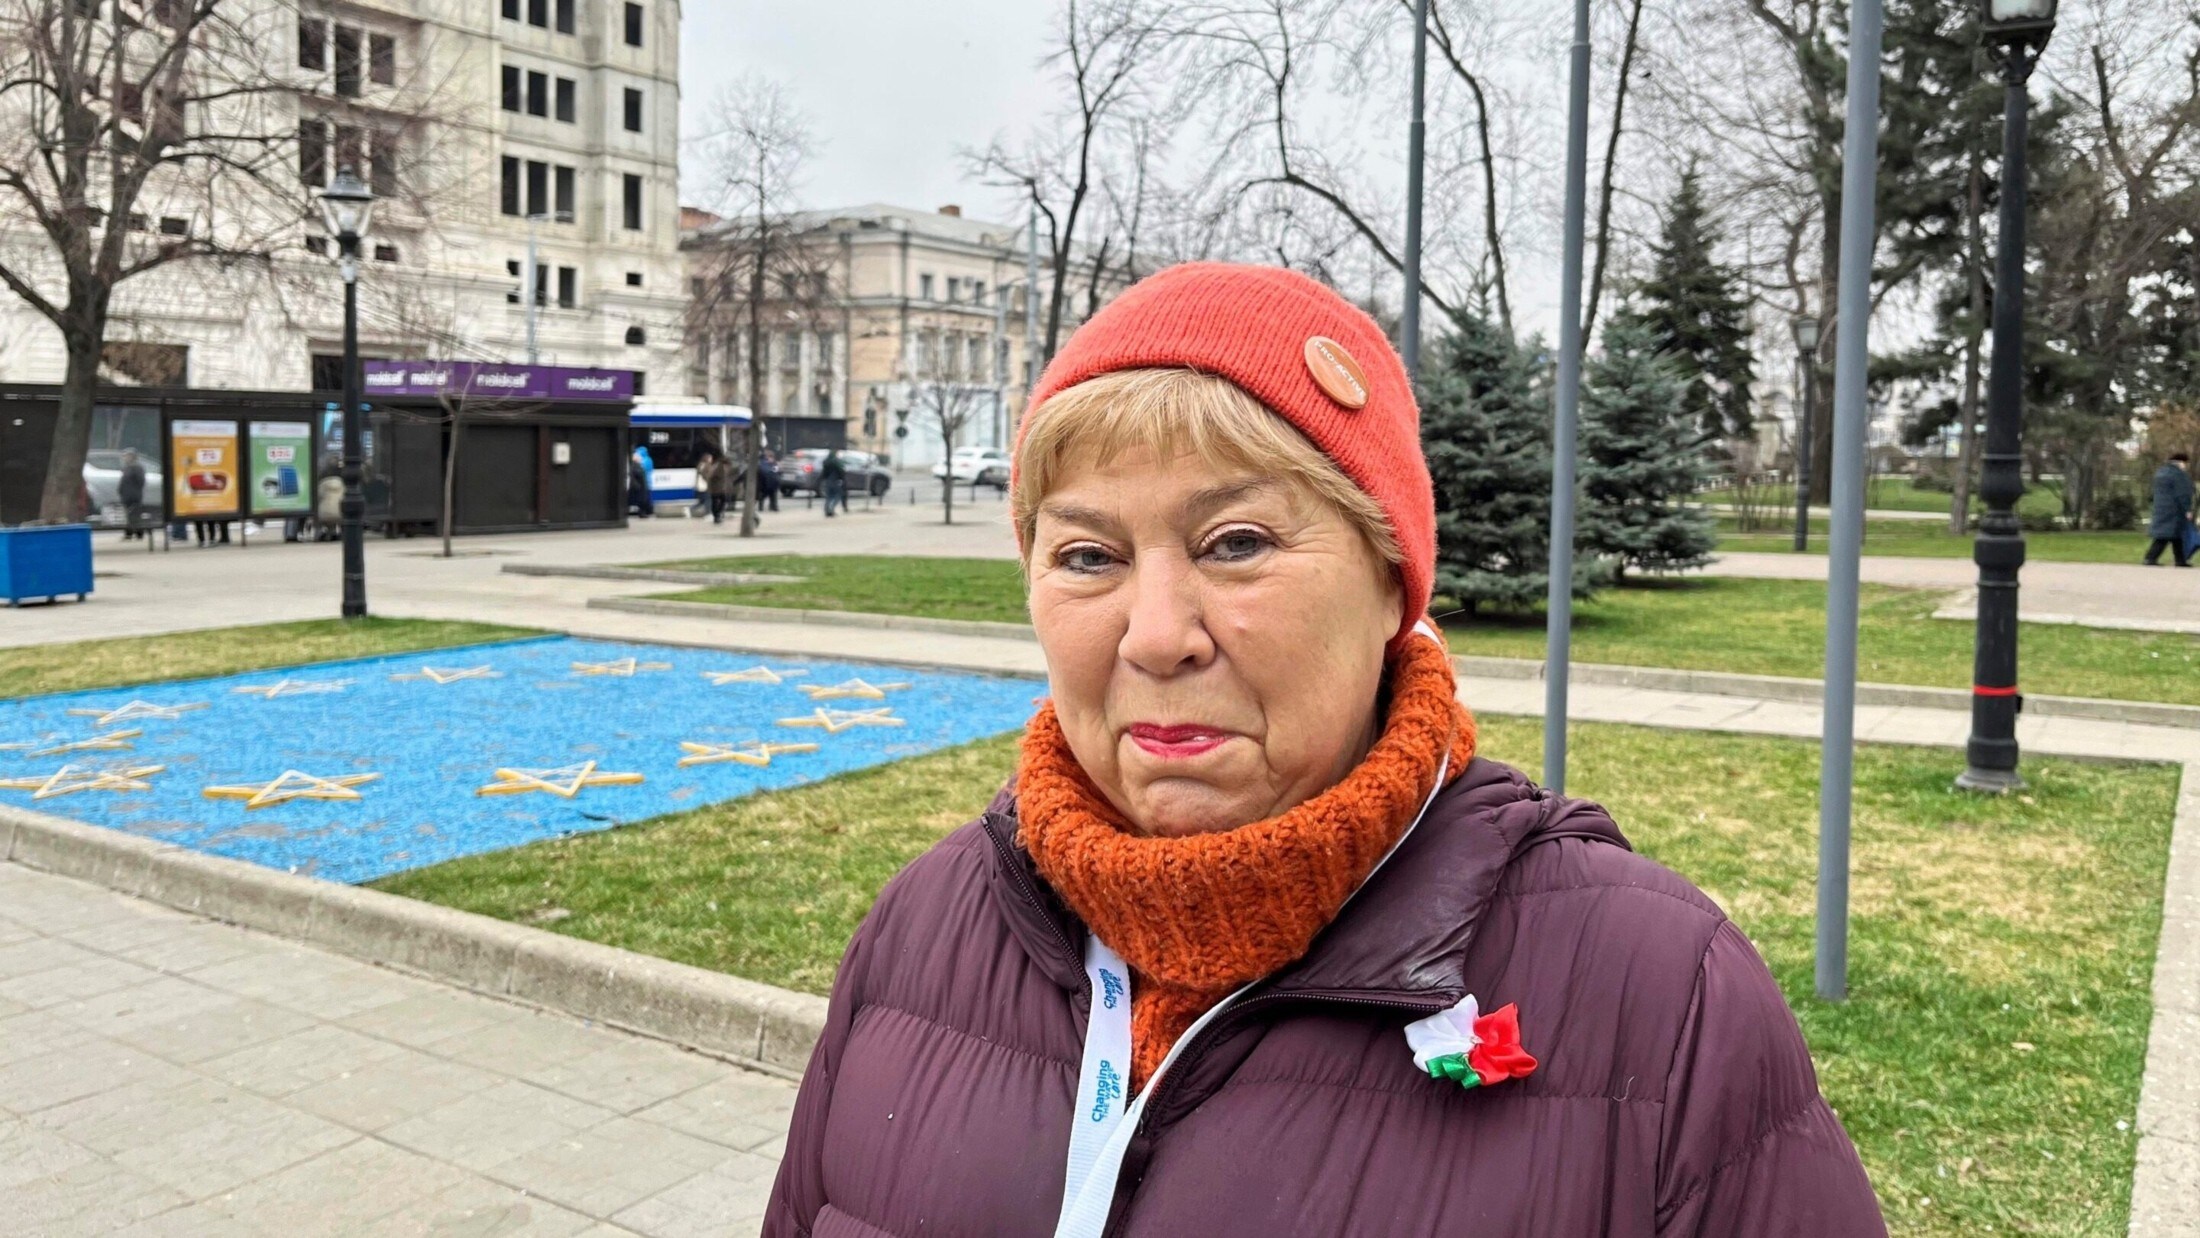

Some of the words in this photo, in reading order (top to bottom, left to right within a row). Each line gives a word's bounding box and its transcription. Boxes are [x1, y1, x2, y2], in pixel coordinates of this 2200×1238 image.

[367, 370, 405, 386] moldcell
[567, 376, 614, 391] moldcell
[1092, 1060, 1110, 1122] Changing
